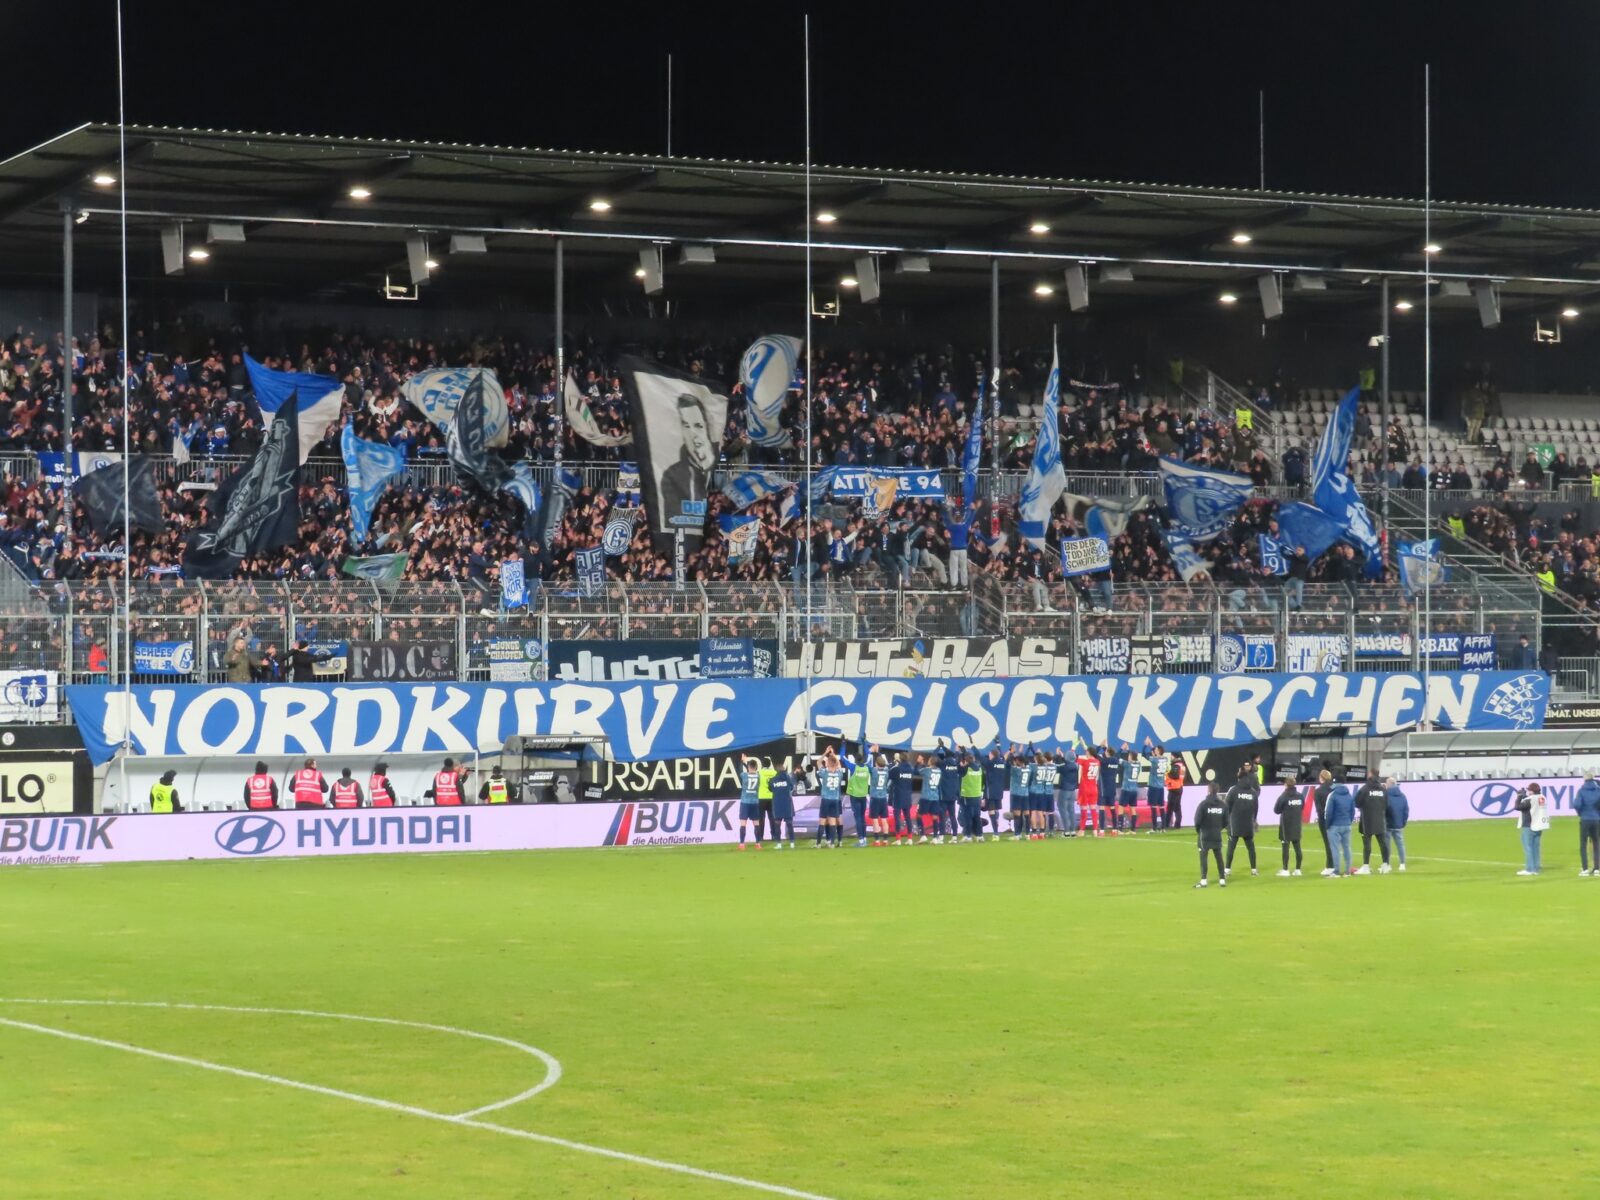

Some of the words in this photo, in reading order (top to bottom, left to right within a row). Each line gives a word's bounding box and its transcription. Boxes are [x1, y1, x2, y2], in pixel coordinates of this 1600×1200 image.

[916, 474, 942, 490] 94
[1081, 637, 1130, 658] MARLER
[1179, 635, 1212, 649] BLUE
[1086, 656, 1128, 672] JUNGS
[102, 686, 736, 763] NORDKURVE
[783, 672, 1481, 752] GELSENKIRCHEN
[747, 777, 758, 790] 17
[1369, 789, 1384, 797] HRS
[1207, 807, 1223, 815] HRS
[297, 815, 472, 848] HYUNDAI
[632, 836, 648, 845] die
[648, 834, 705, 845] Autoflüsterer
[16, 854, 81, 864] Autoflüsterer
